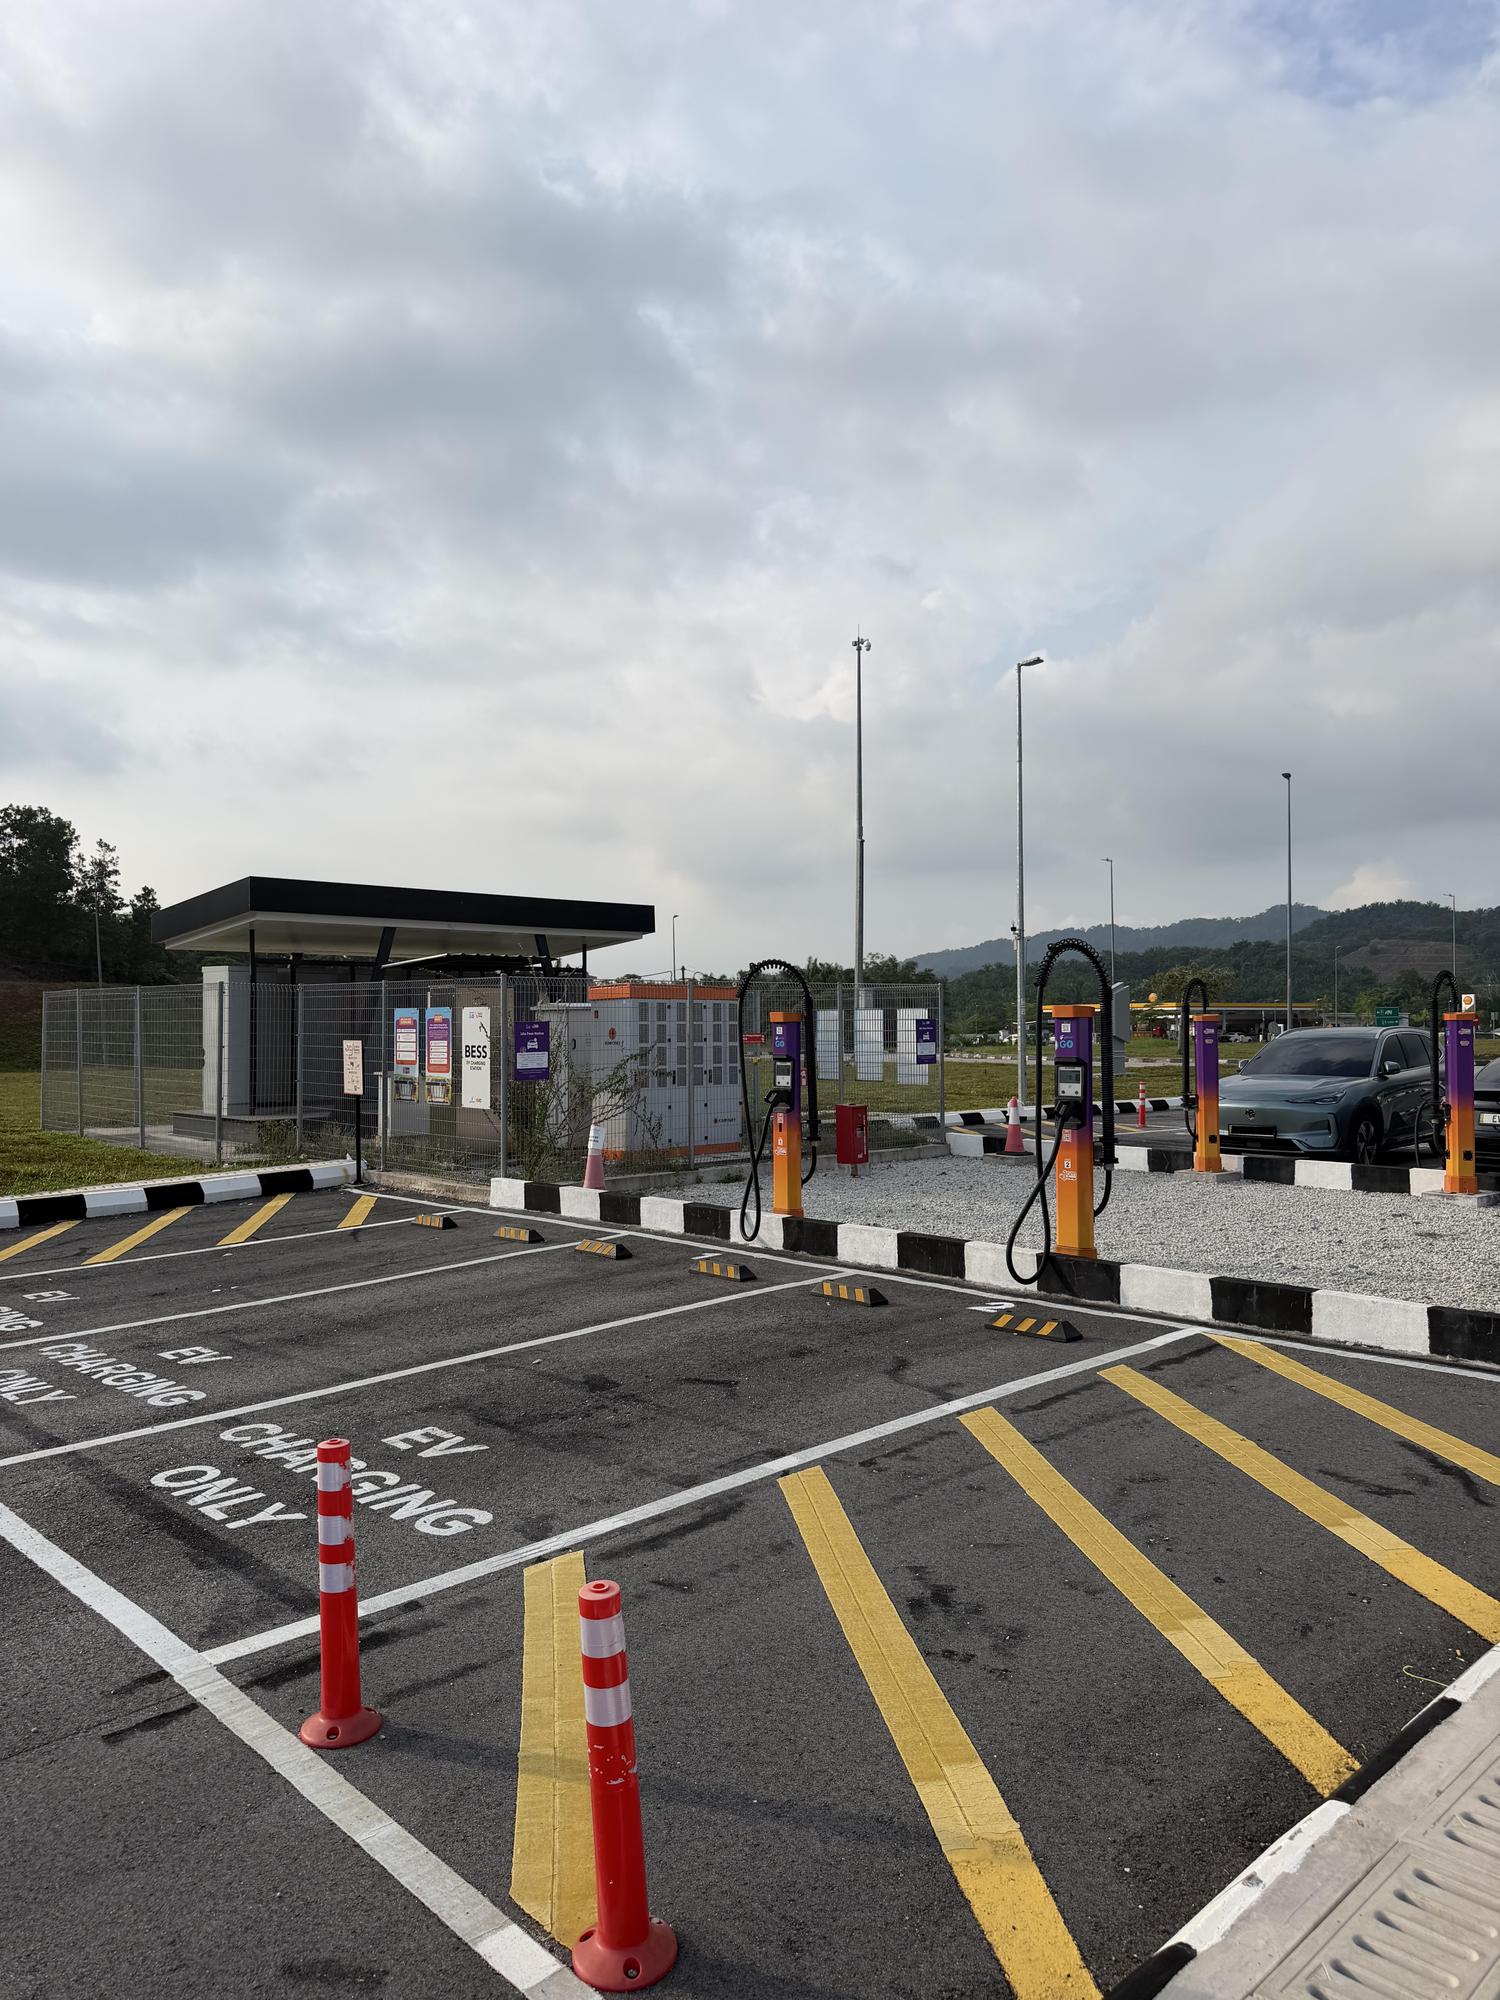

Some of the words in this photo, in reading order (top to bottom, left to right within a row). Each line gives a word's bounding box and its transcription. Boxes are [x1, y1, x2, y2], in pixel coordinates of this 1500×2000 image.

[465, 1045, 487, 1058] BESS
[1059, 1040, 1073, 1049] GO
[22, 1290, 81, 1303] EV
[157, 1346, 233, 1365] EV
[39, 1343, 207, 1407] CHARGING
[381, 1426, 490, 1458] EV
[150, 1465, 308, 1529] ONLY
